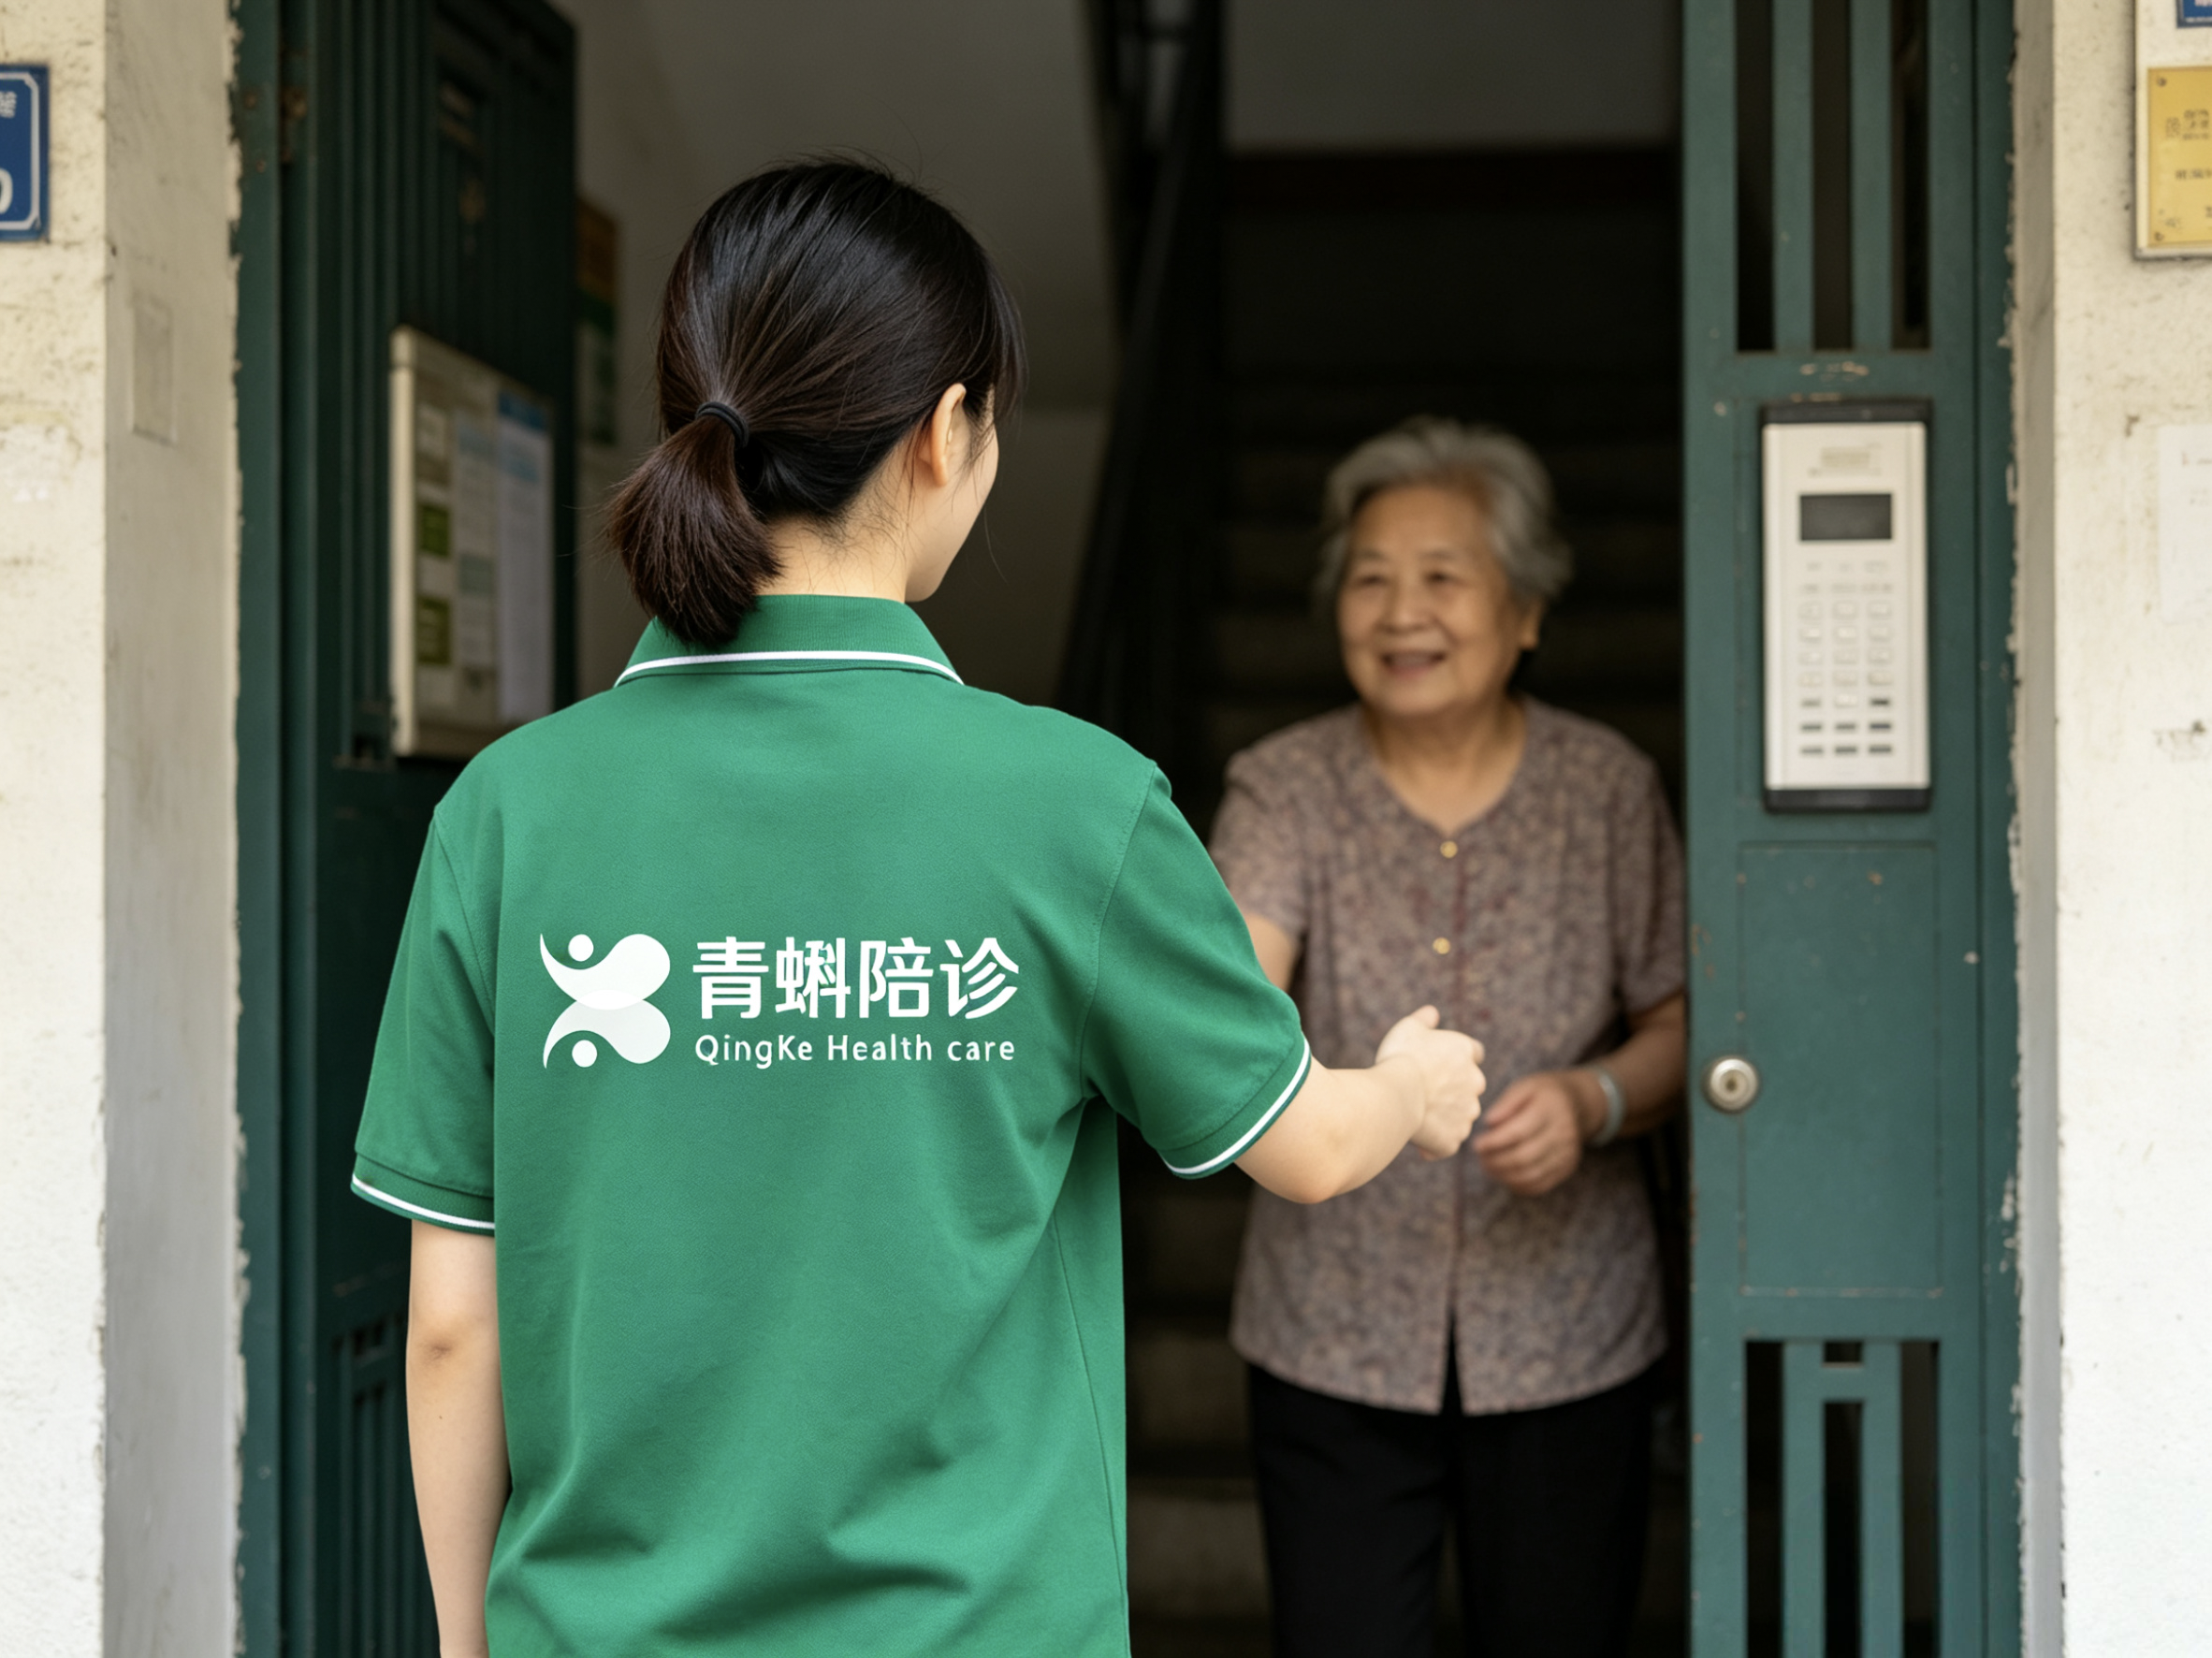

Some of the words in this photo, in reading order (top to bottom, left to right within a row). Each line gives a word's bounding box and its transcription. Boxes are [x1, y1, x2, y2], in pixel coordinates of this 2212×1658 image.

[692, 936, 1019, 1020] 青蝌陪诊
[695, 1034, 812, 1069] QingKe
[827, 1033, 932, 1061] Health
[947, 1040, 1015, 1062] care
